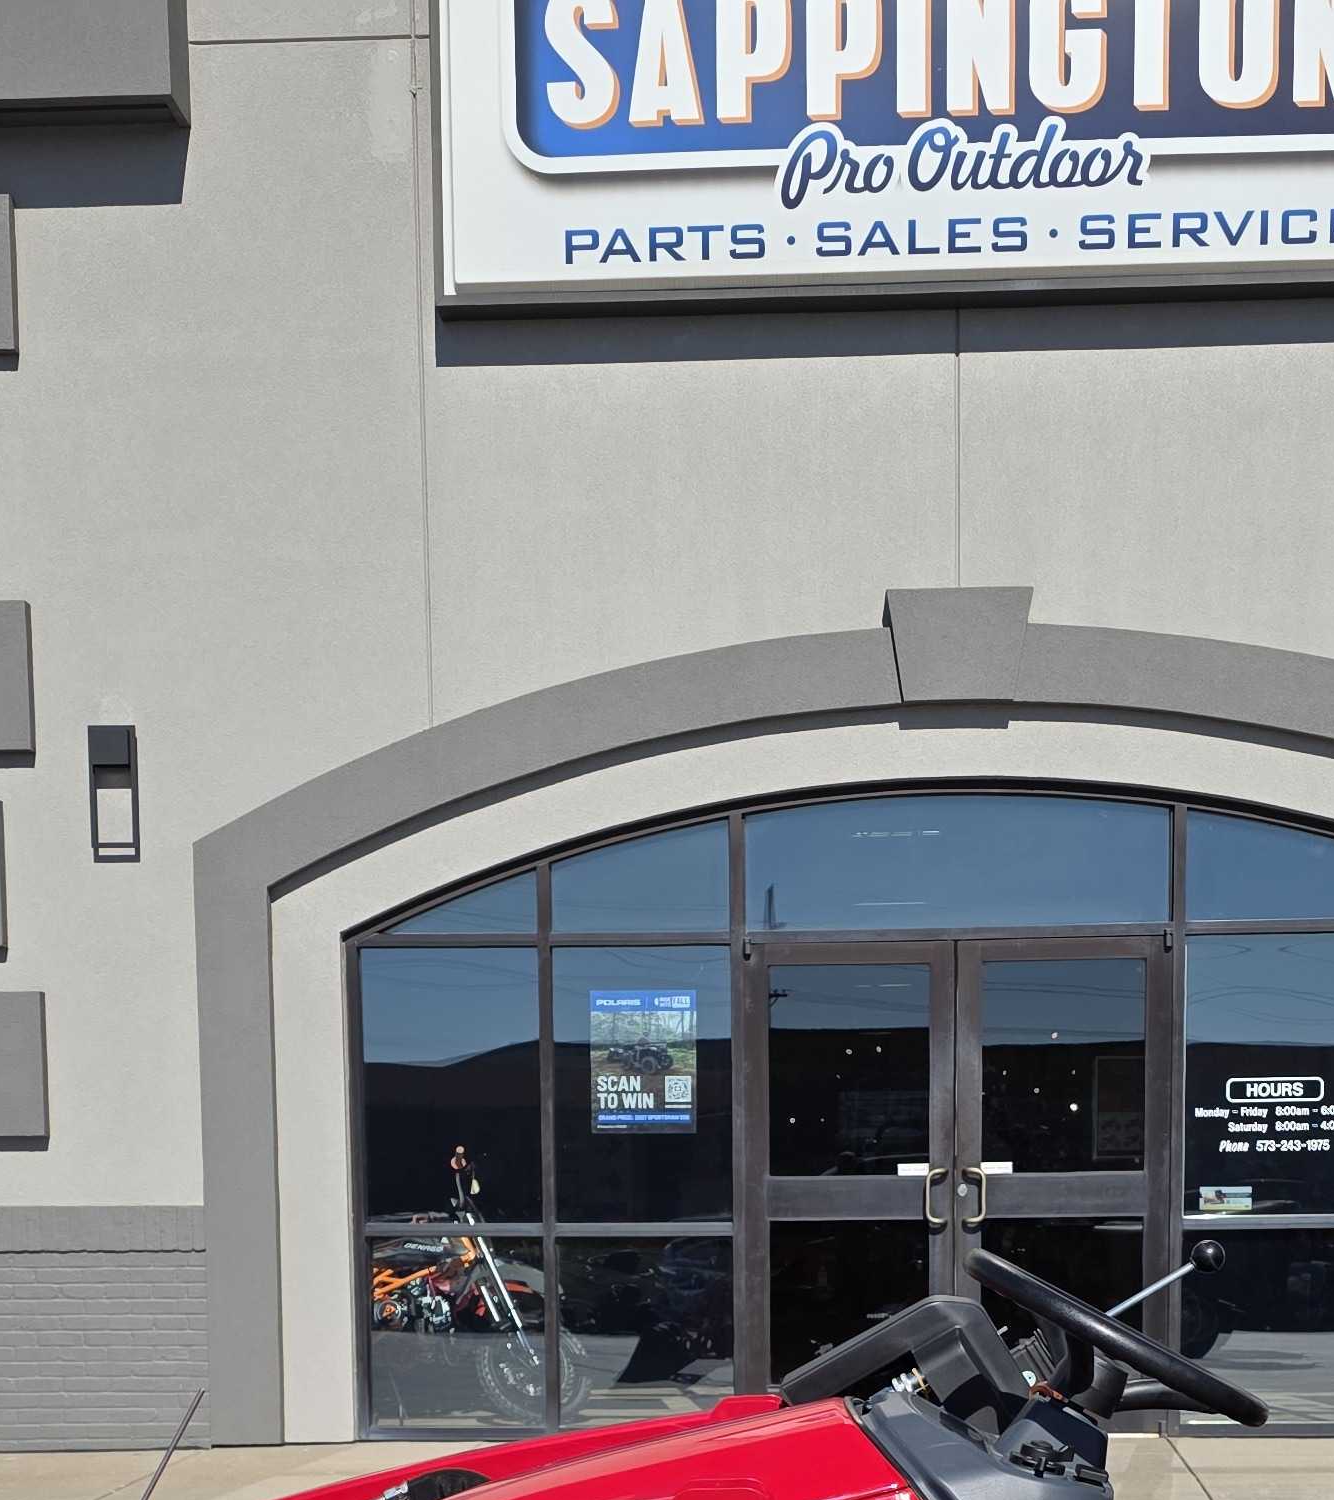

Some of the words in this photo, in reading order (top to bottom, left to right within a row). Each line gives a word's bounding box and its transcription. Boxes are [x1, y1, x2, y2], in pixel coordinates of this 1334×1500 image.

[781, 129, 895, 208] Pro
[907, 123, 1145, 187] Outdoor
[565, 223, 766, 265] PARTS
[815, 216, 1029, 258] SALES
[597, 1075, 641, 1092] SCAN
[1246, 1082, 1304, 1097] HOURS
[597, 1092, 618, 1109] TO
[622, 1092, 654, 1109] WIN
[1195, 1107, 1230, 1118] Monday
[1240, 1106, 1268, 1118] Friday
[1228, 1121, 1268, 1133] Saturday
[1219, 1140, 1249, 1152] Phone
[1255, 1139, 1331, 1151] 573-243-1975
